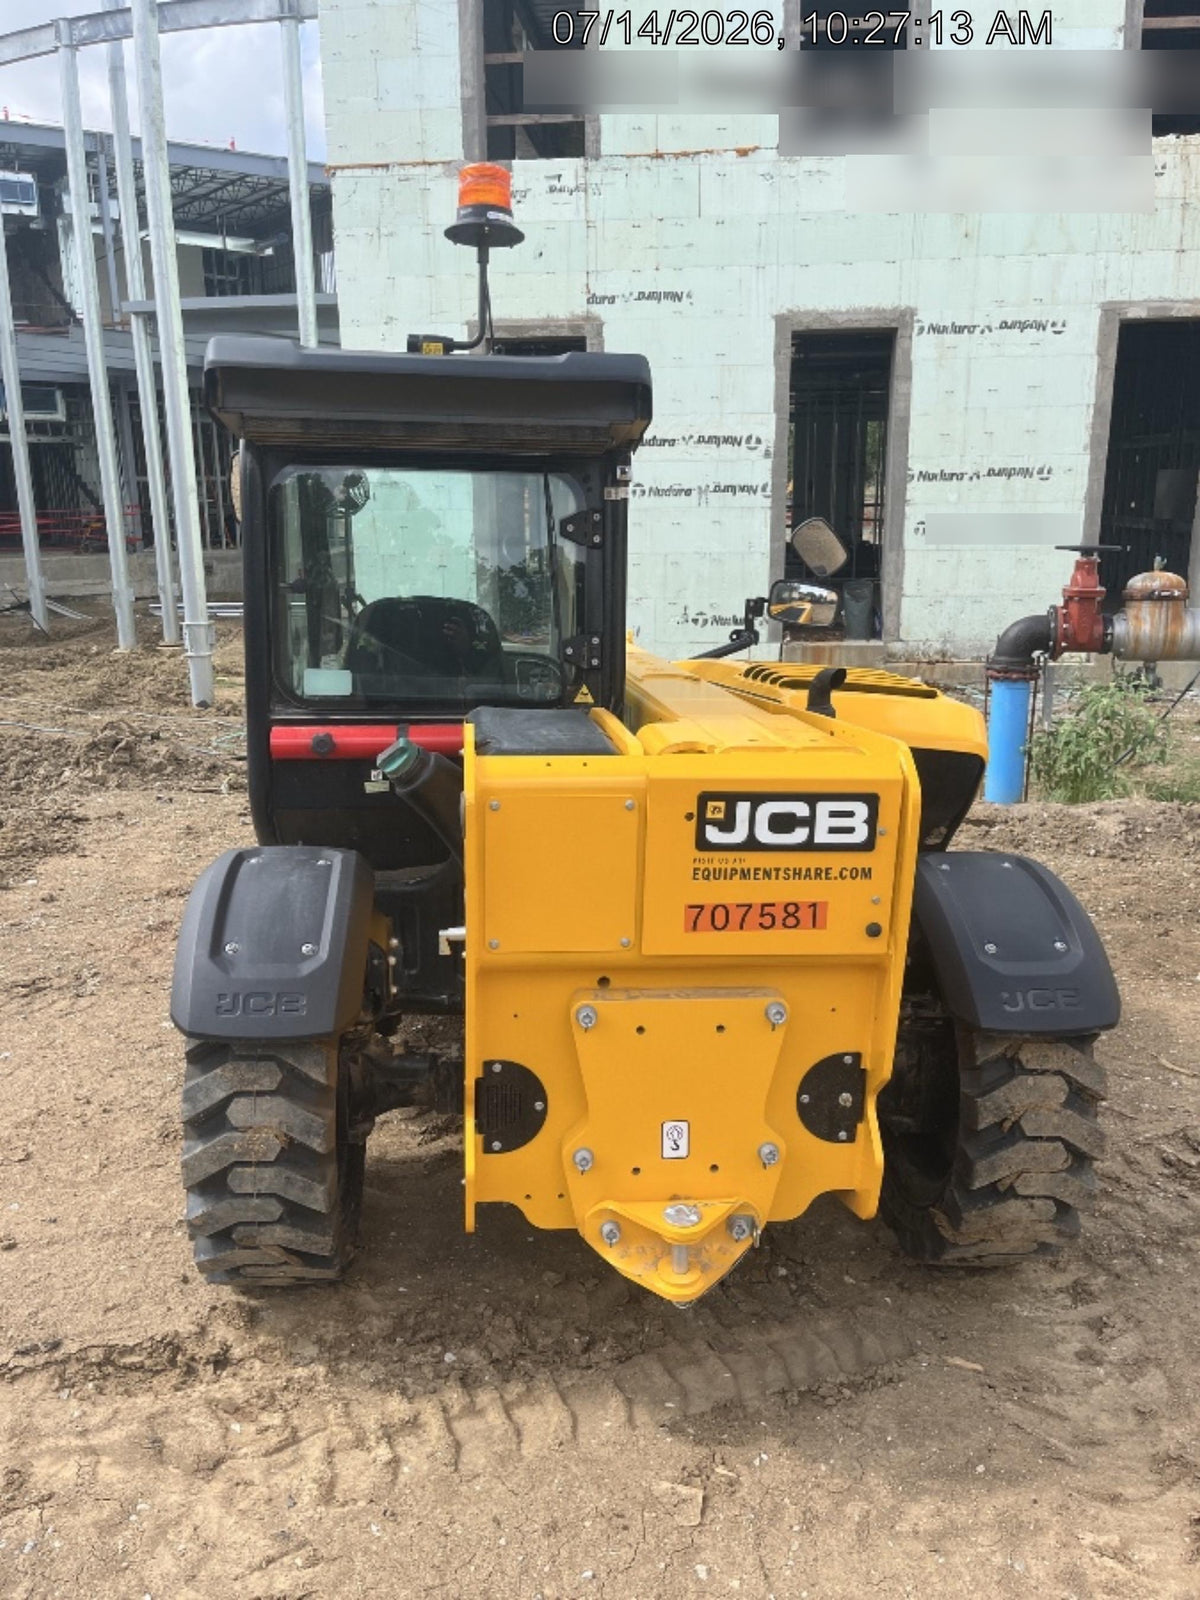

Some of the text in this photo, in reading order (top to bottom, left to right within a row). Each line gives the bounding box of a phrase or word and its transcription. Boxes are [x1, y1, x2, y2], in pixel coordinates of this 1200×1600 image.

[704, 800, 869, 845] JCB
[692, 866, 872, 881] EQUIPMENTSHARE.COM
[687, 902, 819, 932] 707581
[215, 991, 308, 1018] JCB
